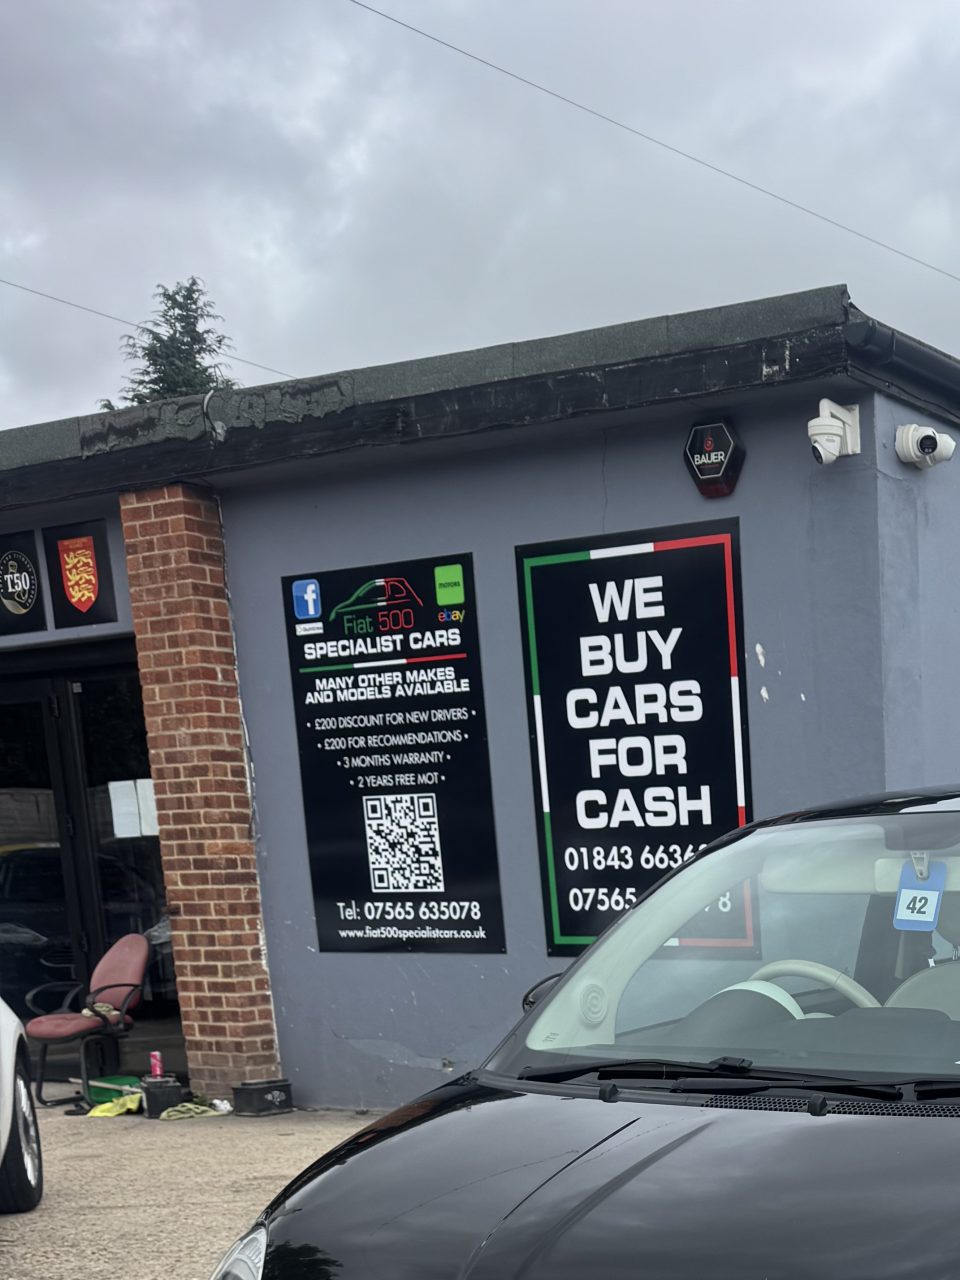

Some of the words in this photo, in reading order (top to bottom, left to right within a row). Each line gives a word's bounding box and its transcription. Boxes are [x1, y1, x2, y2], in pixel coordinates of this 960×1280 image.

[694, 451, 725, 465] BAUER
[4, 572, 30, 592] T50
[589, 575, 665, 623] WE
[343, 614, 374, 635] Fiat
[378, 608, 414, 631] 500
[438, 608, 465, 623] ebay
[303, 634, 404, 660] SPECIALIST
[409, 628, 461, 650] CARS
[579, 627, 683, 678] BUY
[315, 676, 355, 691] MANY
[358, 672, 402, 688] OTHER
[406, 667, 455, 684] MAKES
[305, 690, 334, 704] AND
[337, 686, 391, 702] MODELS
[395, 679, 470, 697] AVAILABLE
[565, 679, 703, 730] CARS
[315, 717, 337, 730] £200
[338, 713, 384, 729] DISCOUNT
[386, 712, 404, 726] FOR
[406, 710, 429, 723] NEW
[431, 707, 469, 722] DRIVERS
[324, 737, 347, 750] £200
[348, 735, 366, 748] FOR
[367, 730, 462, 747] RECOMMENDATIONS
[343, 757, 350, 768] 3
[351, 754, 391, 767] MONTHS
[392, 751, 445, 765] WARRANTY
[588, 734, 688, 778] FOR
[357, 776, 365, 788] 2
[365, 774, 394, 787] YEARS
[395, 773, 416, 786] FREE
[417, 772, 439, 785] MOT
[575, 784, 713, 830] CASH
[564, 845, 634, 871] 01843
[640, 843, 708, 870] 6636
[337, 900, 361, 920] Tel:
[364, 901, 415, 920] 07565
[418, 901, 481, 920] 635078
[568, 887, 637, 912] 07565
[905, 896, 929, 915] 42
[339, 926, 486, 941] www.fiat500specialistcars.co.uk
